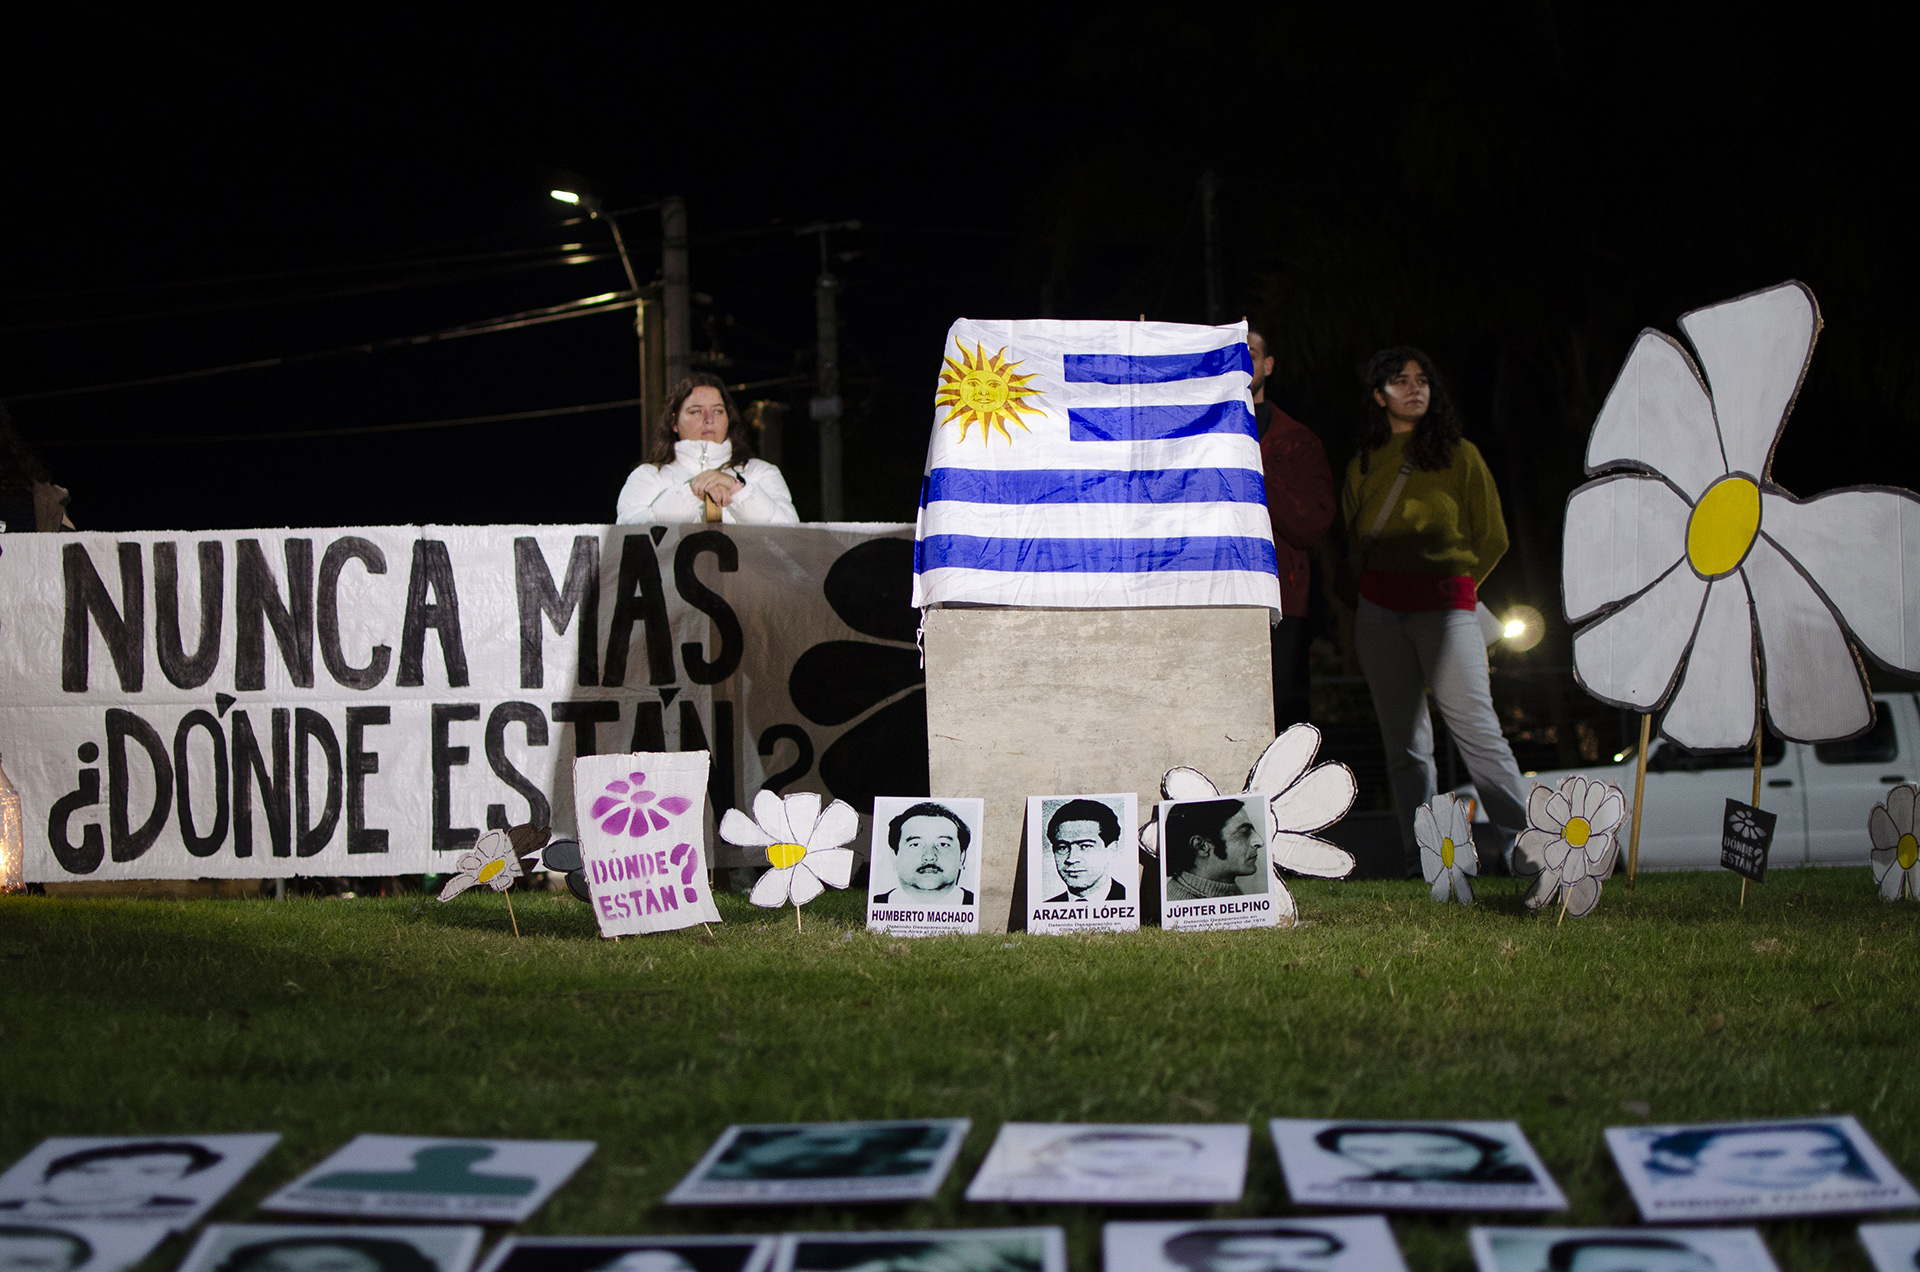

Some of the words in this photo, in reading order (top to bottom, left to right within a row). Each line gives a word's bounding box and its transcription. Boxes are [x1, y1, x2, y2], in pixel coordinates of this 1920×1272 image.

[62, 536, 469, 693] NUNCA
[514, 526, 744, 689] MÁS
[48, 692, 391, 875] ¿DÓNDE
[591, 848, 669, 885] DÓNDE
[872, 910, 924, 922] HUMBERTO
[927, 911, 974, 923] MACHADO
[1033, 906, 1088, 920] ARAZATÍ
[1093, 905, 1135, 919] LÓPEZ
[1166, 905, 1216, 918] JÚPITER
[1220, 900, 1270, 914] DELPINO
